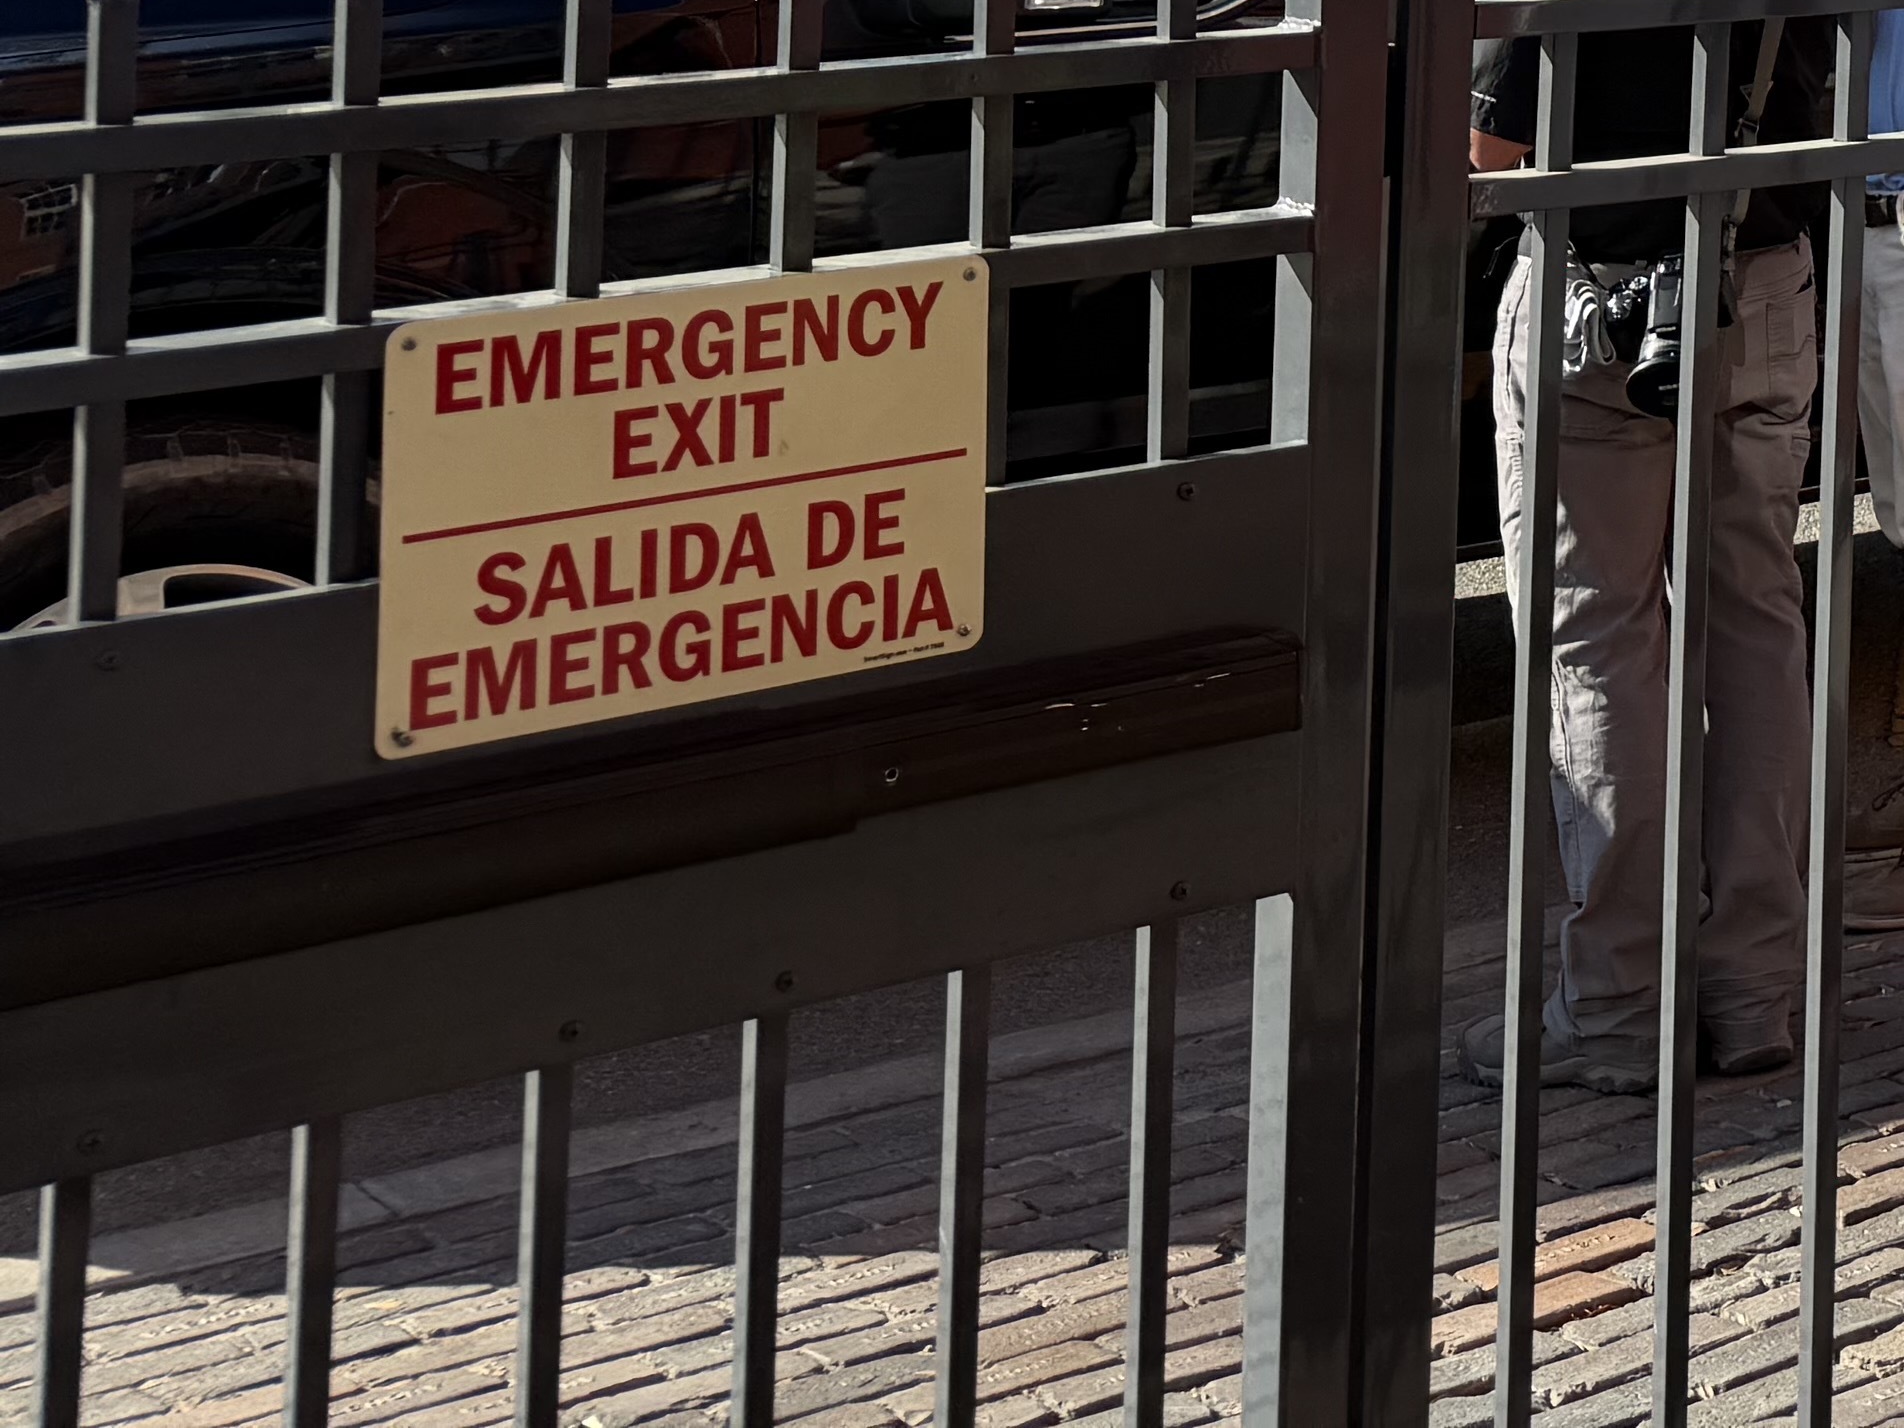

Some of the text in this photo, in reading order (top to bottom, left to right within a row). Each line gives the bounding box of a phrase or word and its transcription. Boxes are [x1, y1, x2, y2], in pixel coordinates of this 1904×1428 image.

[434, 282, 943, 416] EMERGENCY
[612, 388, 785, 480] EXIT
[473, 489, 906, 627] SALIDA DE
[409, 568, 954, 731] EMERGENCIA
